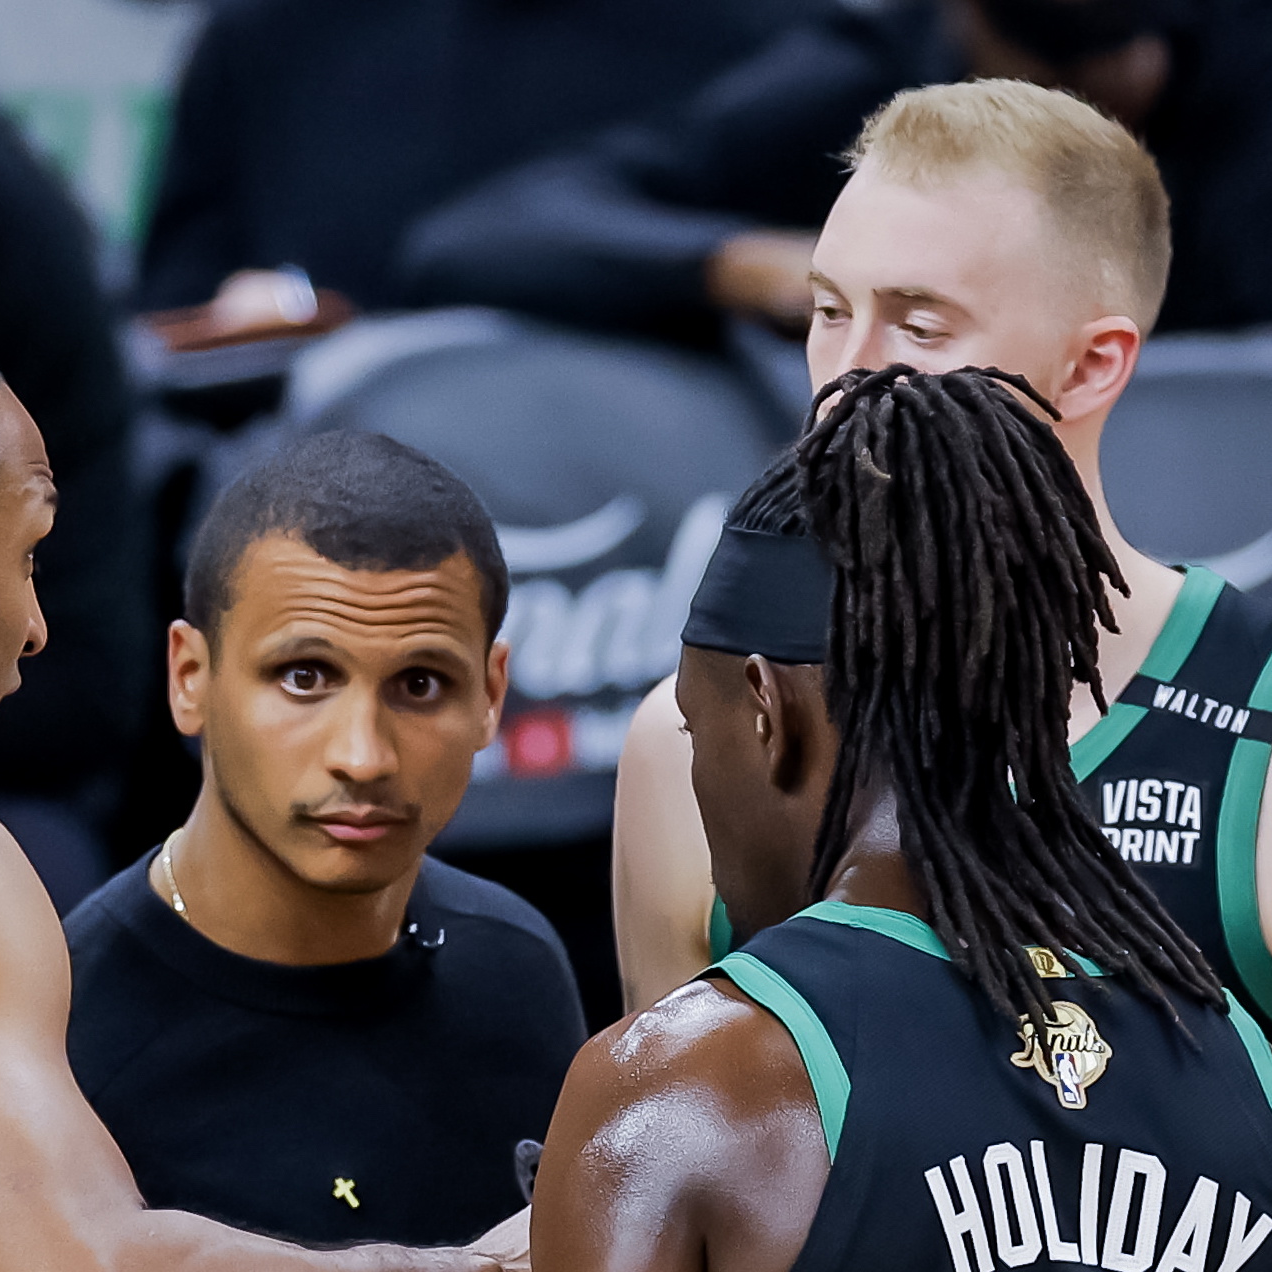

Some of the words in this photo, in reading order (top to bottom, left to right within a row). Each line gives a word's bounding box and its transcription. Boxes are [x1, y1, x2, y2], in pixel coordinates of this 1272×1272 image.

[1152, 683, 1251, 735] WALTON
[1102, 778, 1202, 831] VISTA
[1100, 826, 1201, 865] PRINT
